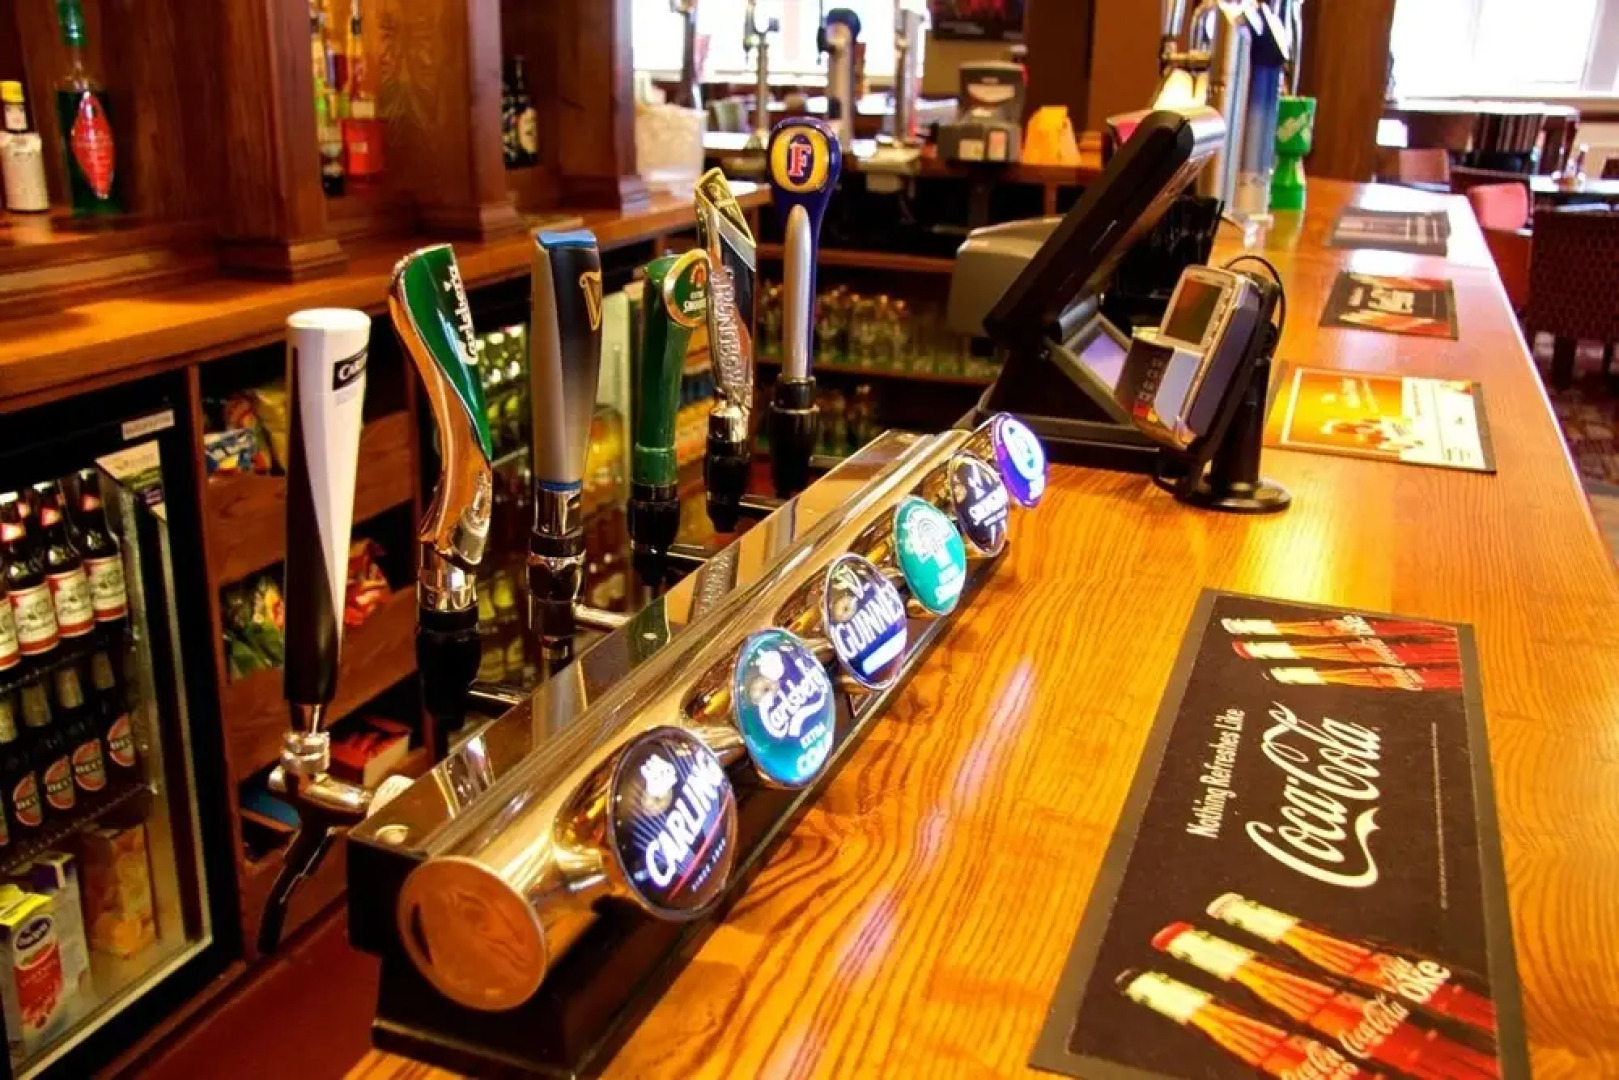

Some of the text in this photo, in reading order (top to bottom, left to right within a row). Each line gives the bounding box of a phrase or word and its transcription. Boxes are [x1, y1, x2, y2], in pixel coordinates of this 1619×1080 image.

[788, 141, 811, 177] F
[645, 749, 724, 887] CARLING
[1186, 708, 1245, 838] Nothing Refreshes Like
[1245, 701, 1381, 887] Coca-Cola
